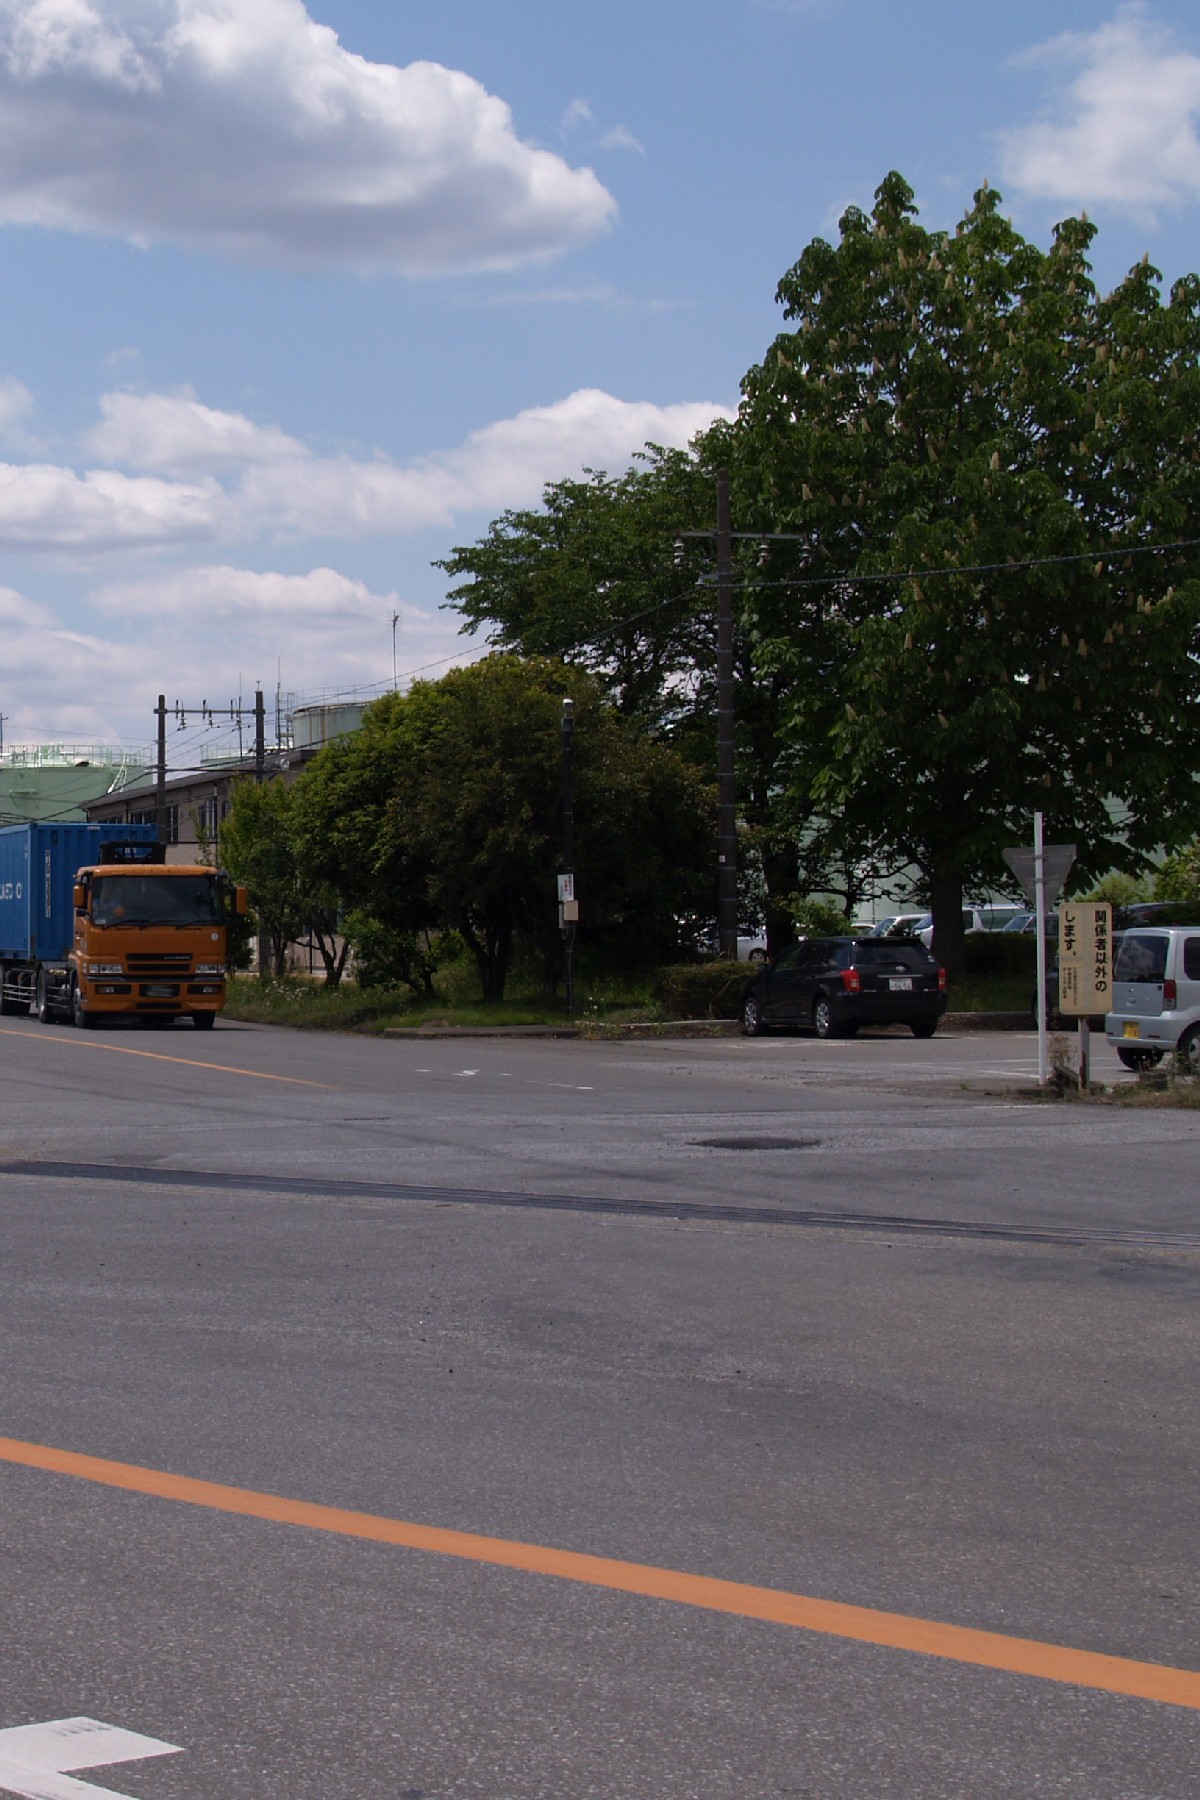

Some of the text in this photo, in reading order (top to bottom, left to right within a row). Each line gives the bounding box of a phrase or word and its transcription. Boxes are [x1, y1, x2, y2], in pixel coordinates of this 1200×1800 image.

[1094, 909, 1108, 993] 関係者以外の
